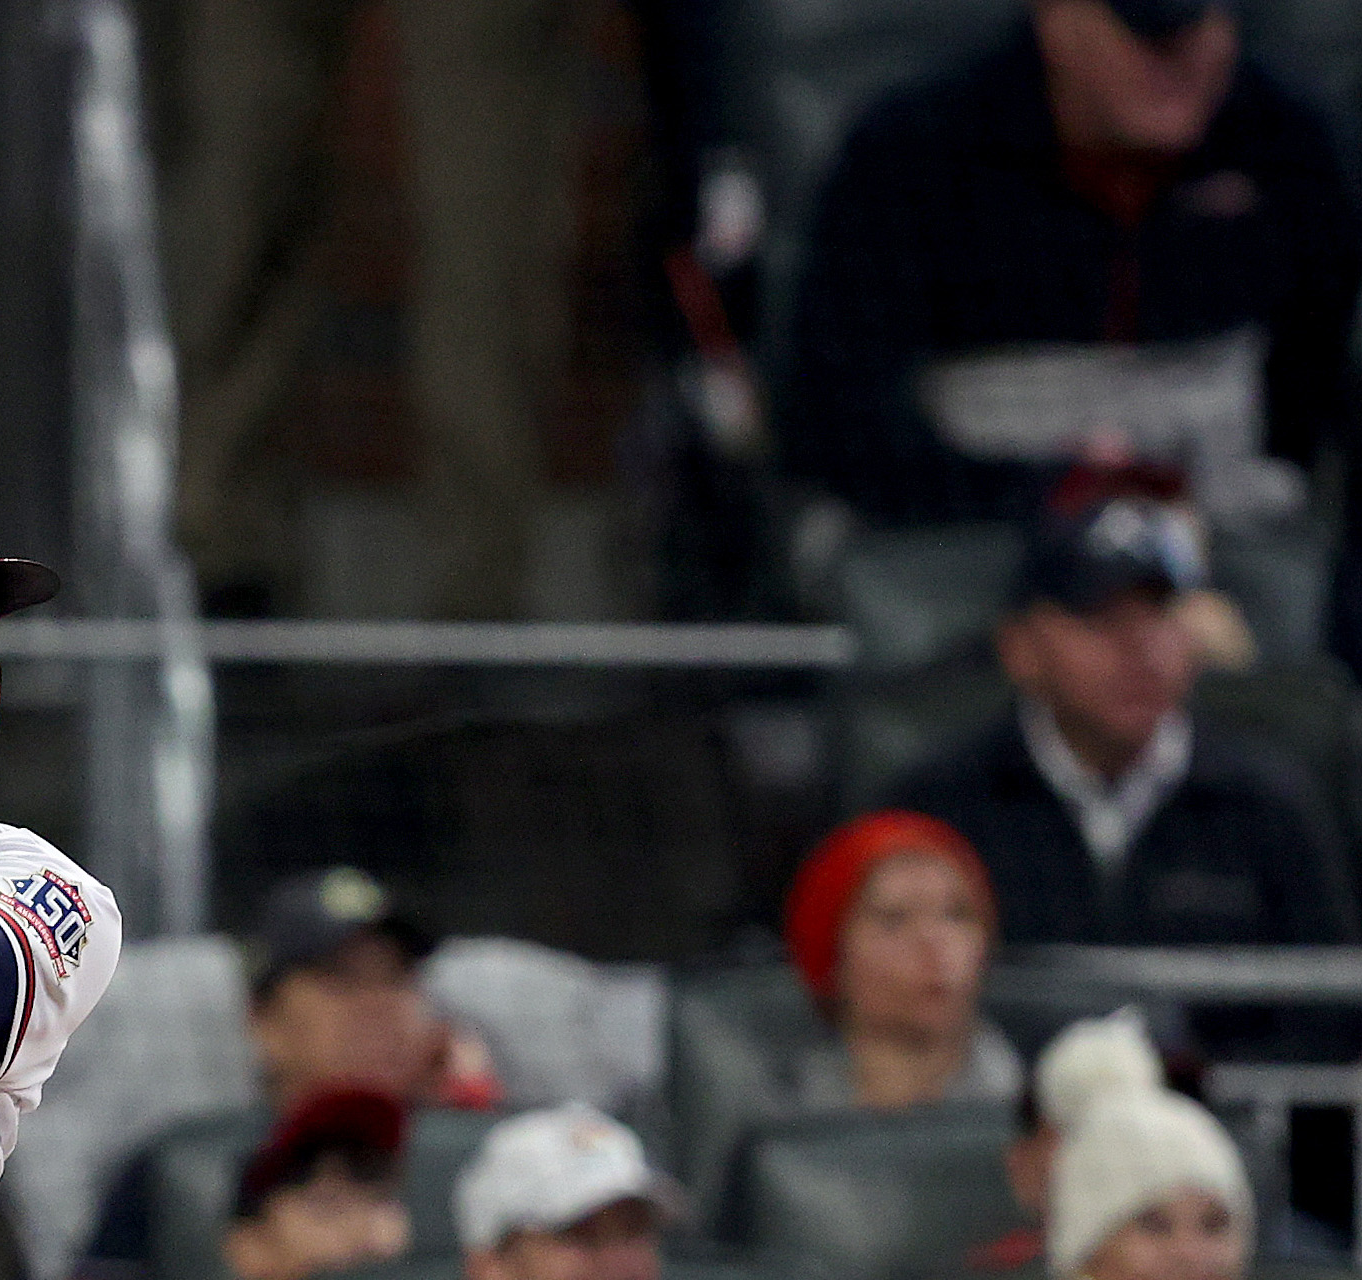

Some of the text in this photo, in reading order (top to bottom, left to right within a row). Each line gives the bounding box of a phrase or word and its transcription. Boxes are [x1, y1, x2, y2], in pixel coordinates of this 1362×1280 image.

[14, 873, 86, 955] 150
[47, 872, 90, 920] BRAVES
[15, 904, 59, 957] ANNIVERSARY
